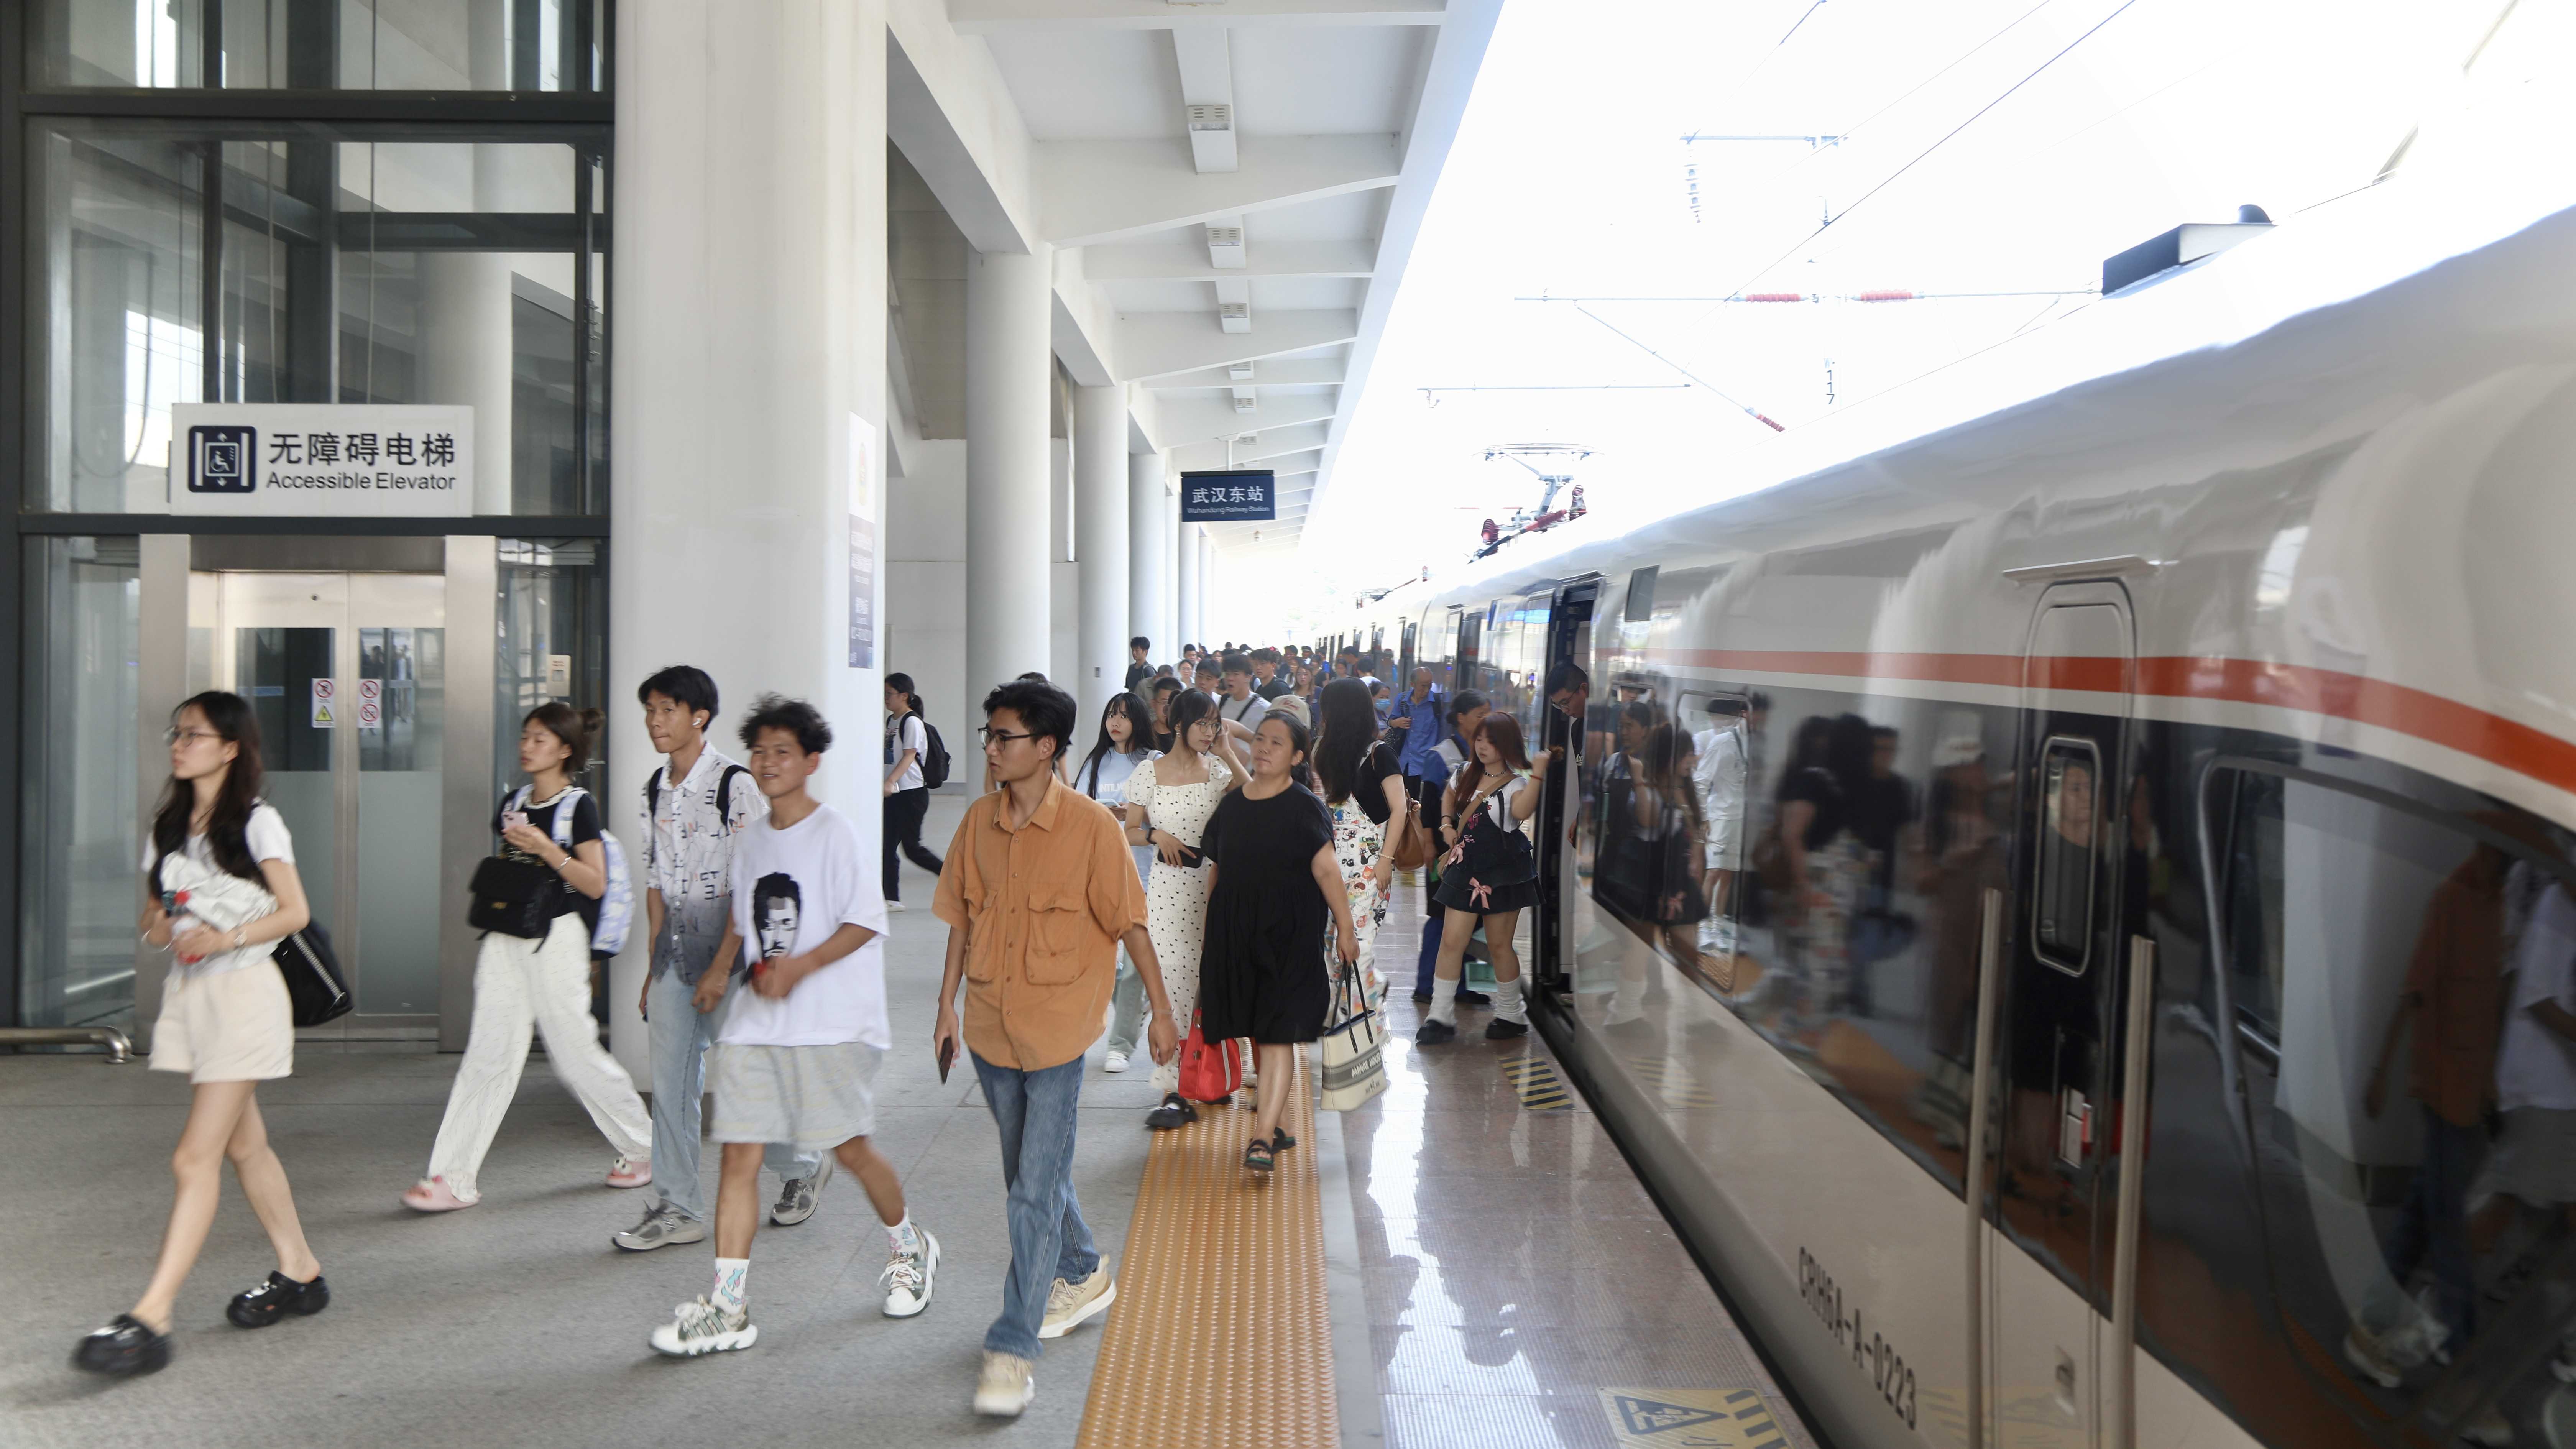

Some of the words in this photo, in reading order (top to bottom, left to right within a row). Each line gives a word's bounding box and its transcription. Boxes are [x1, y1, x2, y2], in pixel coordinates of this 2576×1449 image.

[269, 432, 455, 467] 无障碍电梯
[266, 472, 371, 490] Accessible
[376, 473, 456, 490] Elevator
[1192, 486, 1264, 503] 武汉东站
[1799, 1247, 1916, 1430] CRH6A-A-0223
